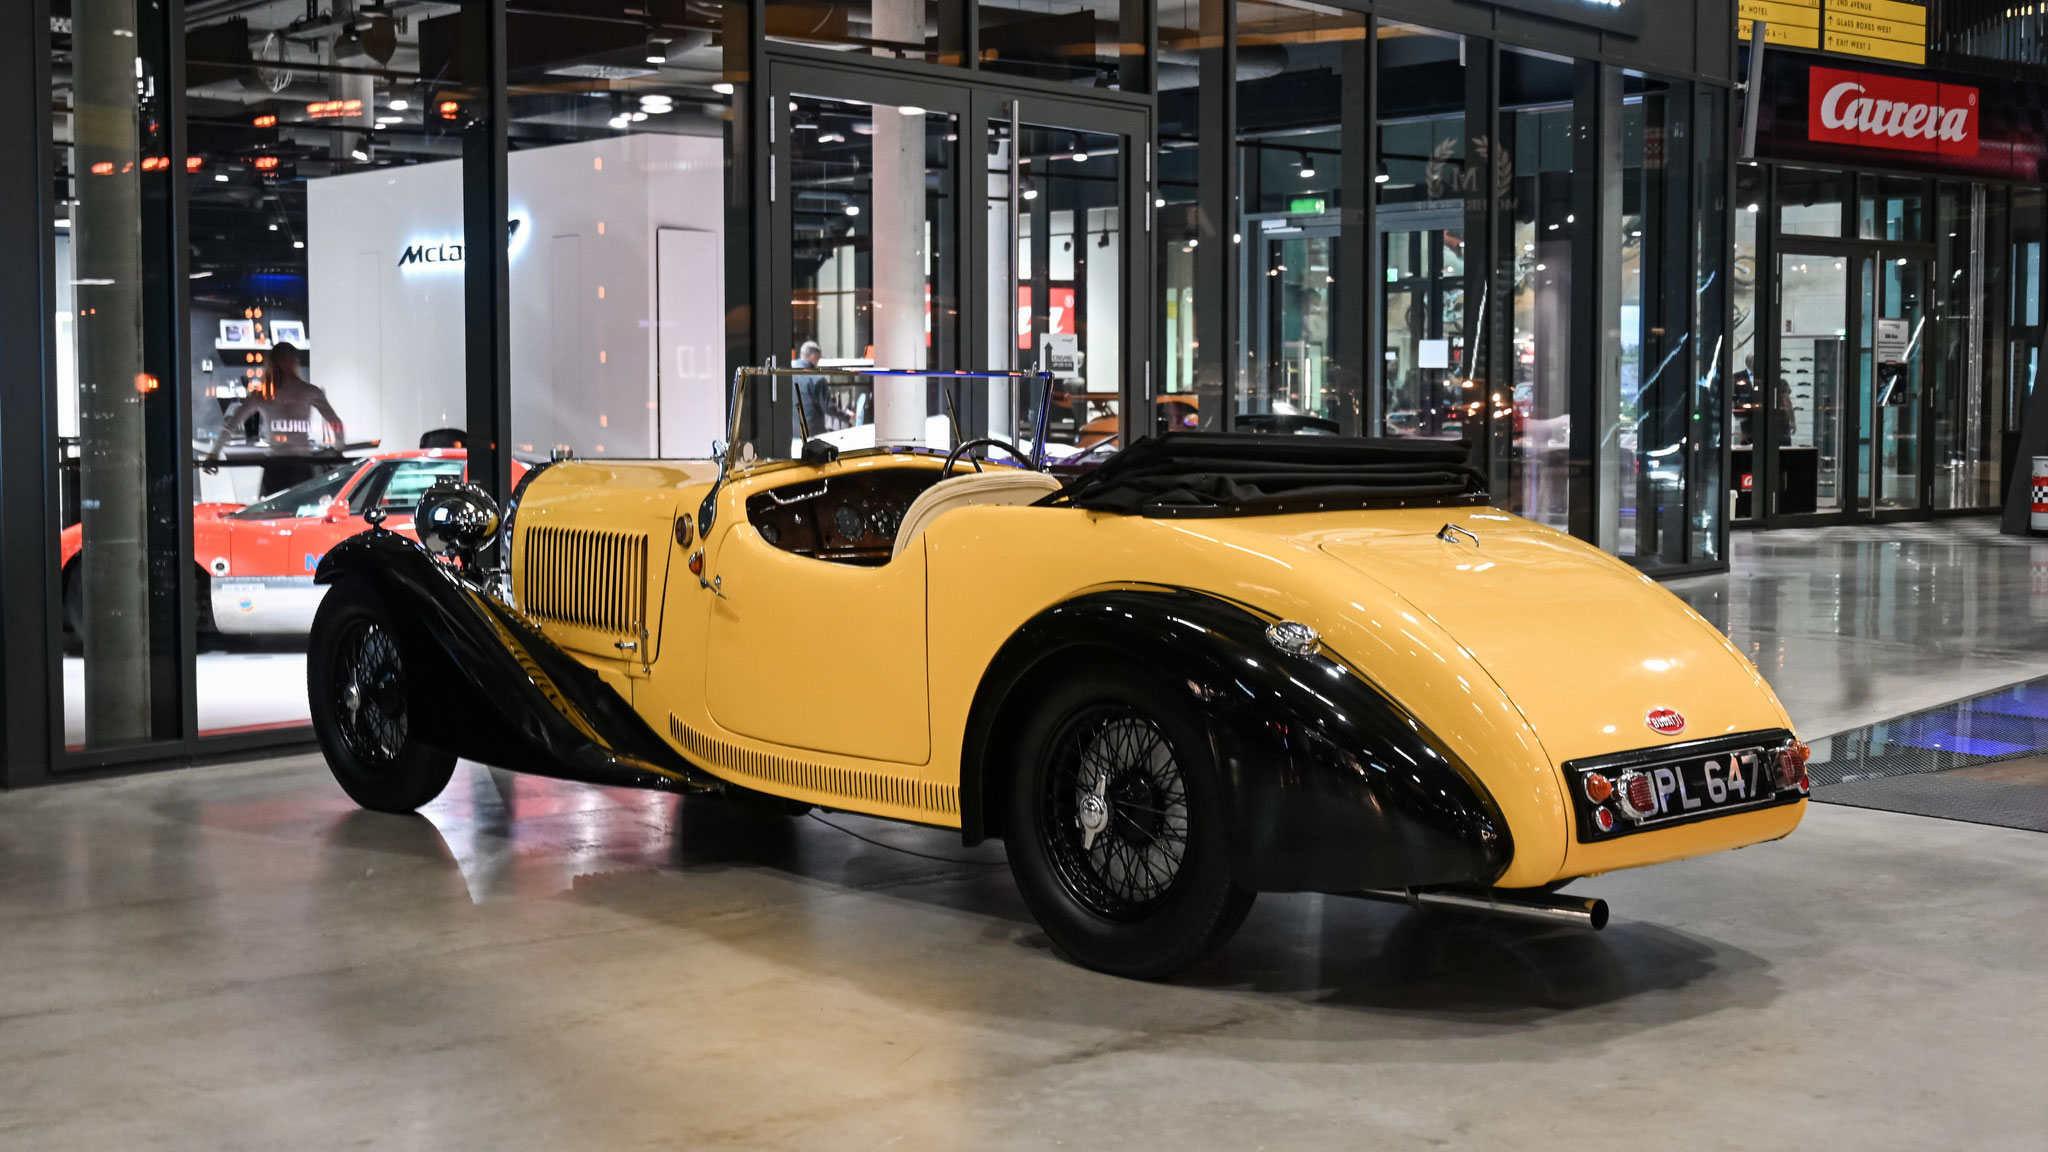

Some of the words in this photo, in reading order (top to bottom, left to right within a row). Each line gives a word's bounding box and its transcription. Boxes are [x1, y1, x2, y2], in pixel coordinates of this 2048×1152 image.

[1749, 6, 1768, 16] HOTEL
[1850, 1, 1872, 11] AVENUE
[1836, 18, 1854, 28] GLASS
[1856, 21, 1875, 31] BOXES
[1877, 25, 1892, 34] WEST
[1836, 39, 1848, 47] EXIT
[1851, 41, 1866, 50] WEST
[1821, 82, 1969, 142] Carrera
[398, 243, 466, 267] McLa
[1651, 712, 1682, 728] BUGATTI
[1704, 753, 1759, 803] 647
